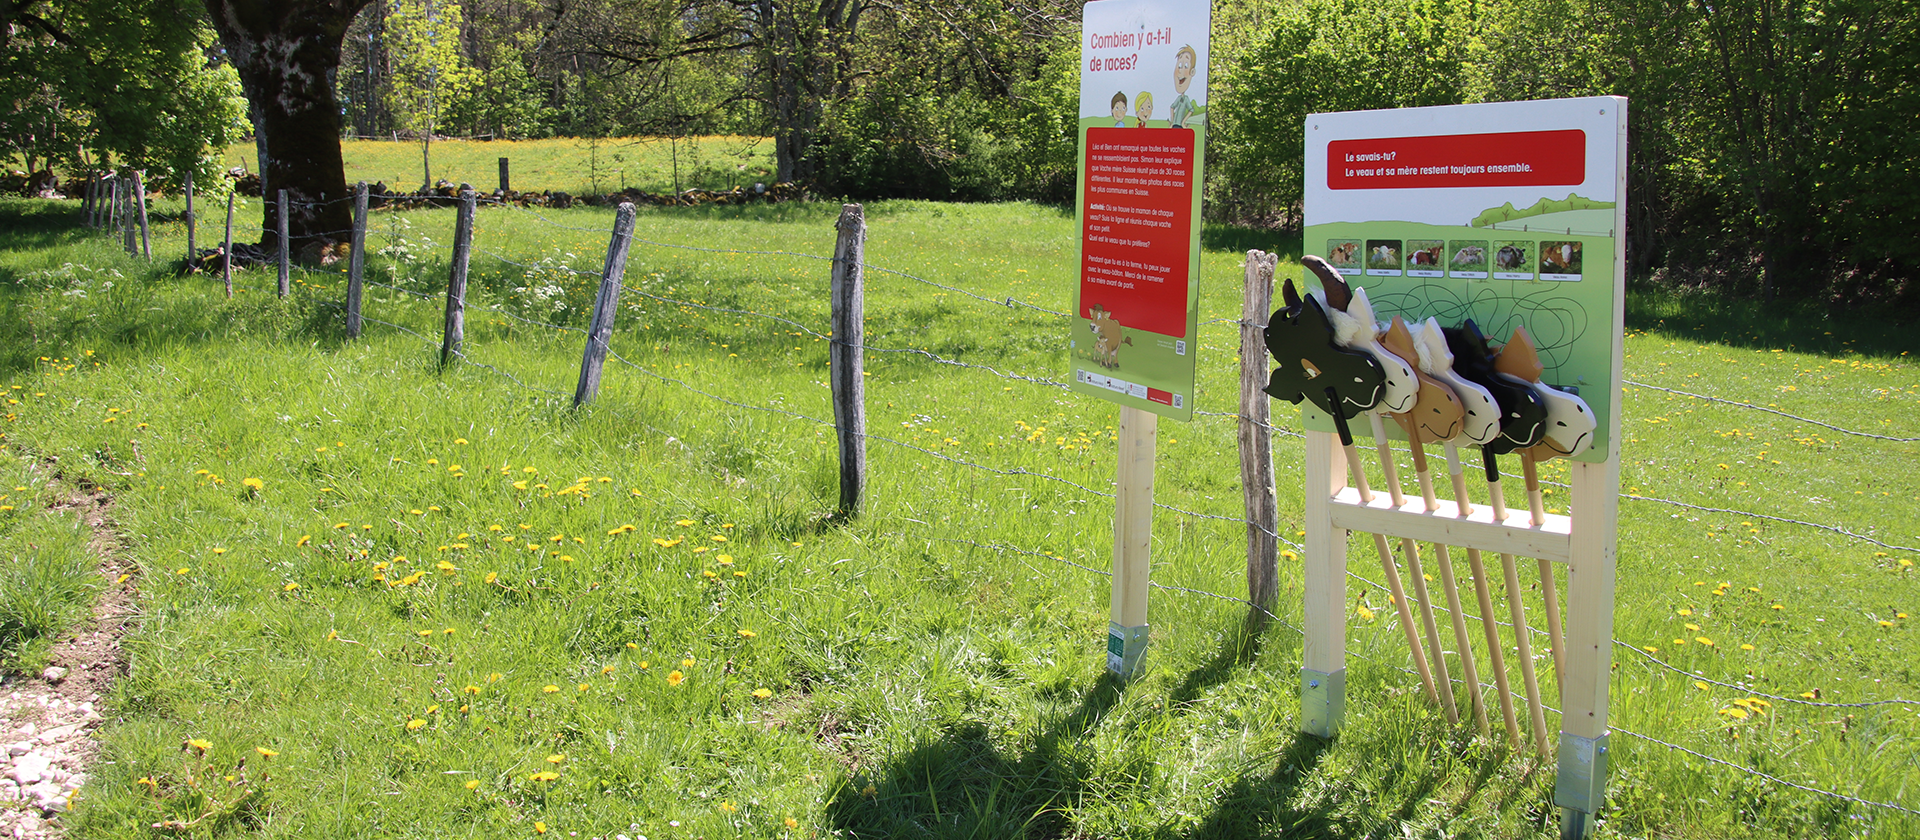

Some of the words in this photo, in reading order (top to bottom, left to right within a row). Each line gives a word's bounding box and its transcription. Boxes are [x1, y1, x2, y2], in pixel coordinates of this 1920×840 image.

[1090, 31, 1134, 49] Combien
[1138, 32, 1144, 50] y
[1146, 27, 1171, 45] a-t-il
[1090, 56, 1102, 72] de
[1104, 53, 1138, 71] races?
[1164, 157, 1182, 165] explique
[1345, 153, 1355, 162] Le
[1356, 152, 1396, 162] savais-tu?
[1345, 168, 1354, 177] Le
[1356, 168, 1374, 177] veau
[1376, 168, 1384, 176] et
[1386, 168, 1396, 176] sa
[1398, 165, 1418, 176] mère
[1420, 164, 1449, 175] restent
[1450, 164, 1485, 176] toujours
[1487, 162, 1533, 174] ensemble.
[1158, 210, 1174, 218] chaque
[1116, 216, 1124, 224] ligne
[1142, 219, 1158, 227] chaque
[1088, 254, 1104, 263] Pendant
[1159, 265, 1171, 273] jouer
